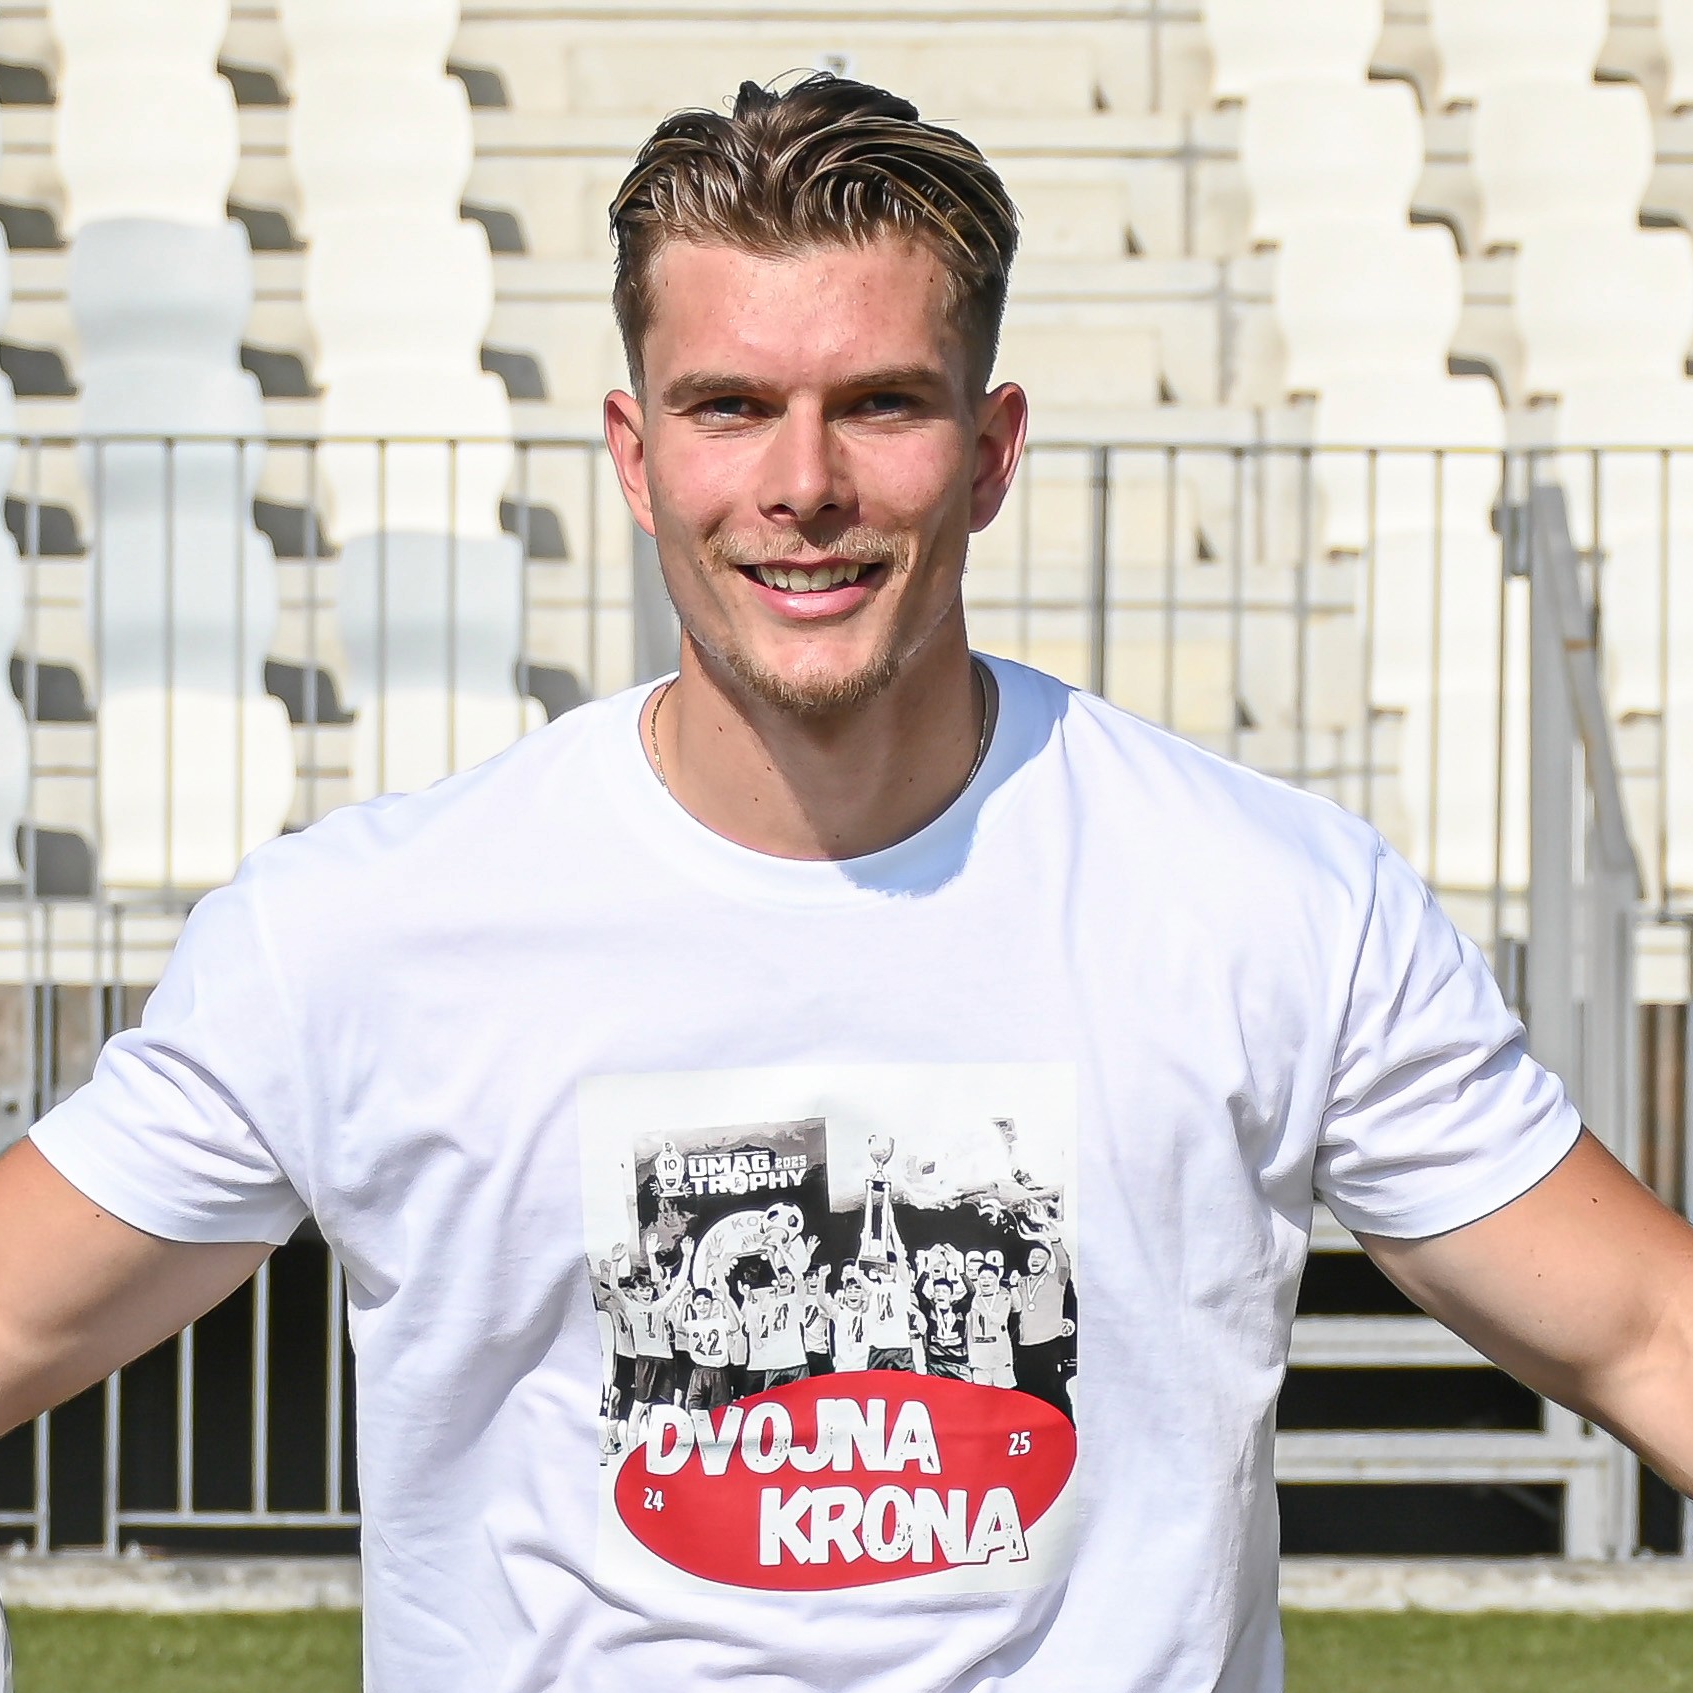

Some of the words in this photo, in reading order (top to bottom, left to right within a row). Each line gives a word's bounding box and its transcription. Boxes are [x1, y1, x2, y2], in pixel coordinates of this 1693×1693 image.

[664, 1159, 677, 1170] 10
[688, 1154, 771, 1177] UMAG
[775, 1155, 807, 1169] 2025
[689, 1168, 807, 1195] TROPHY
[645, 1398, 942, 1476] DVOJNA
[1008, 1431, 1031, 1456] 25
[643, 1487, 664, 1513] 24
[759, 1485, 1029, 1567] KRONA
